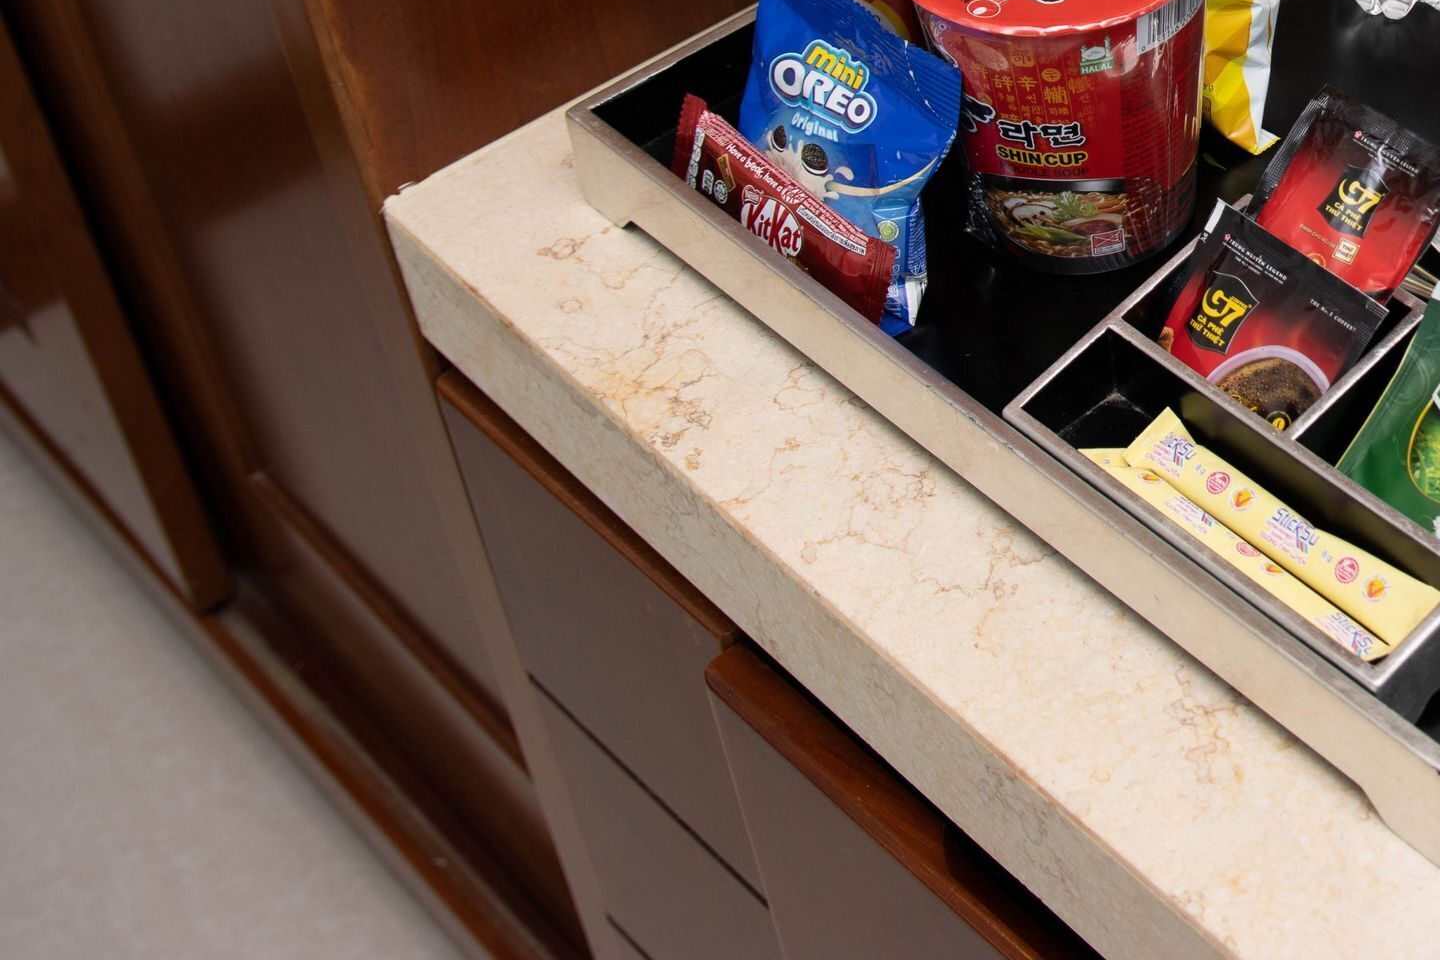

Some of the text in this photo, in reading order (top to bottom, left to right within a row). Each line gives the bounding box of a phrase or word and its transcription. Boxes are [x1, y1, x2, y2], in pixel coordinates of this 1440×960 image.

[805, 45, 864, 90] mini
[1081, 62, 1113, 74] HALAL
[773, 58, 871, 124] OREO
[791, 112, 840, 143] Original
[996, 120, 1086, 149] 라면
[725, 143, 742, 160] Have
[743, 158, 763, 178] break,
[762, 172, 778, 188] have
[1338, 178, 1381, 215] G7
[745, 197, 801, 256] KitKat
[1230, 238, 1287, 281] TRUNG NGUYÊN LEGEND
[1197, 313, 1225, 337] CÀ PHÊ
[1202, 287, 1247, 328] G7
[1202, 325, 1226, 347] THIỆT
